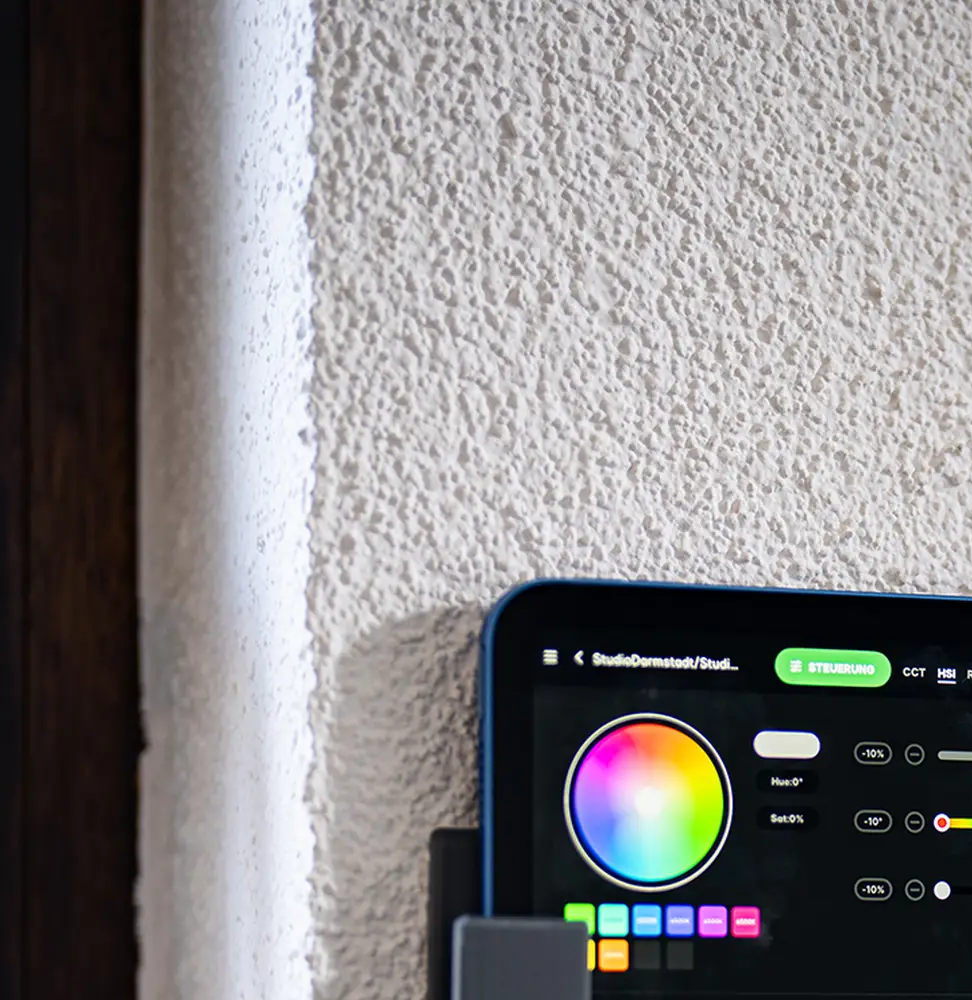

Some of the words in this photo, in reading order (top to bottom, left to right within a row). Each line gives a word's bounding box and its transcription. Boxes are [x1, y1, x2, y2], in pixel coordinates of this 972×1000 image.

[807, 661, 875, 676] STEUERUNG
[902, 667, 926, 679] CCT
[937, 668, 956, 679] HSI
[861, 748, 884, 759] -10%
[770, 813, 804, 824] Sat:0%
[861, 885, 885, 895] -10%
